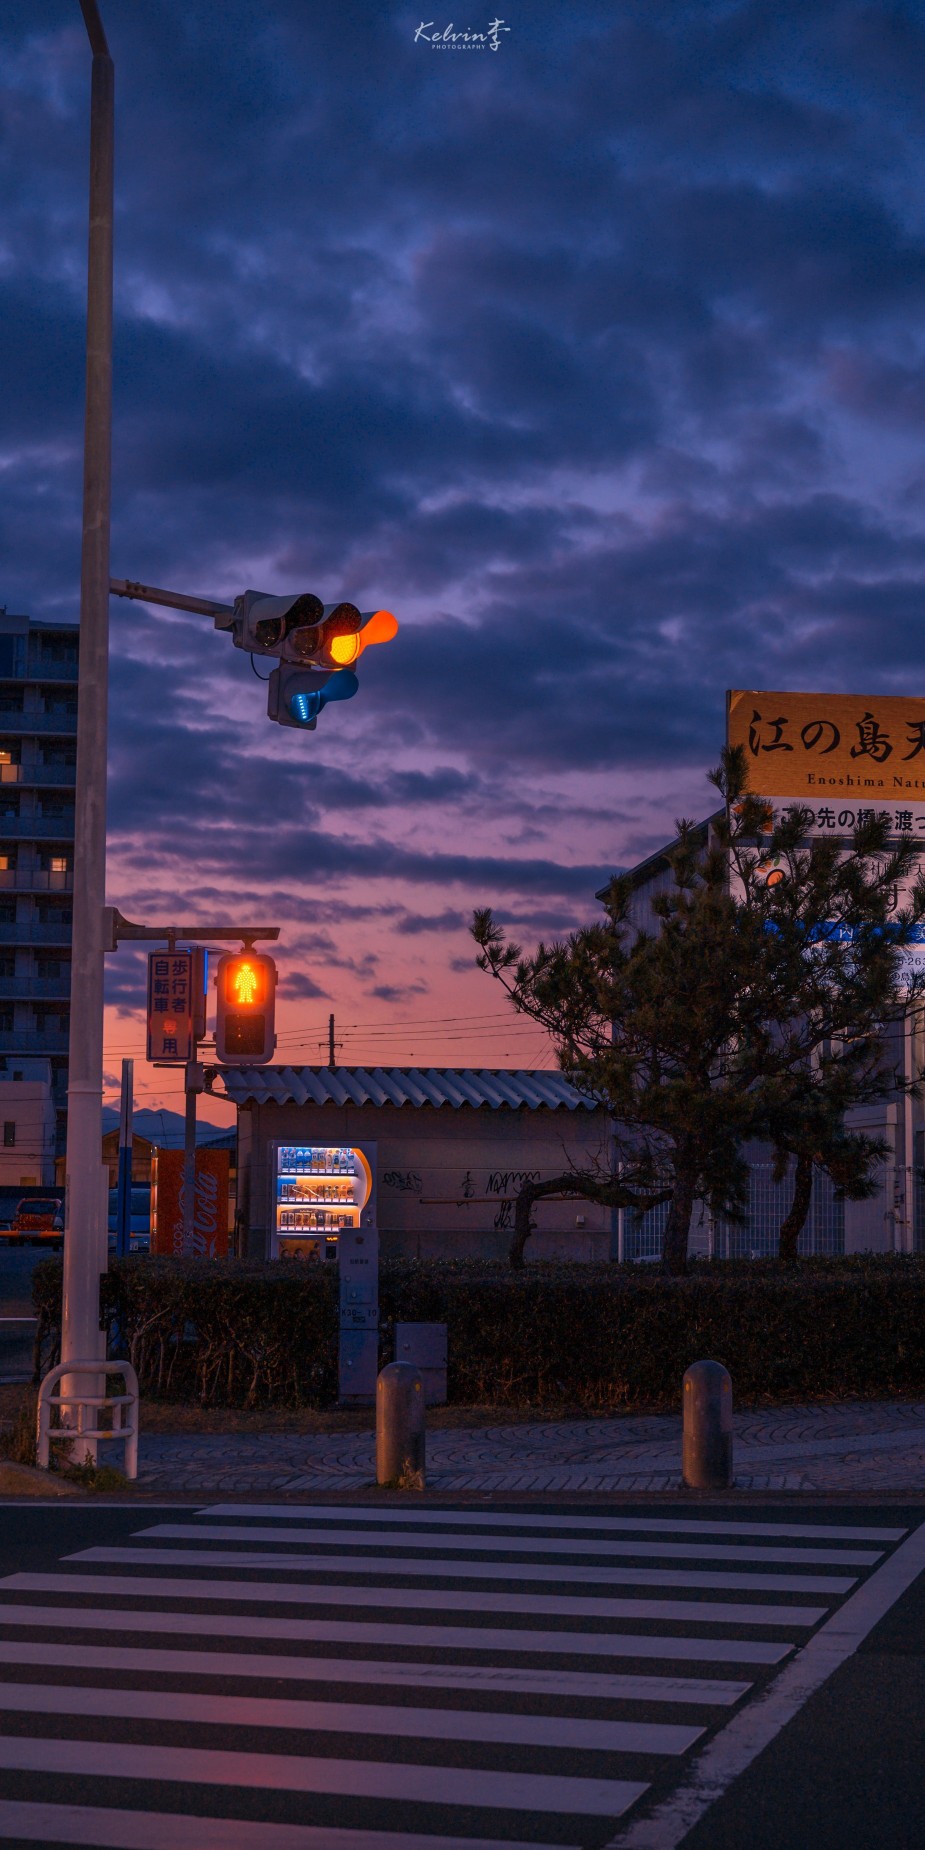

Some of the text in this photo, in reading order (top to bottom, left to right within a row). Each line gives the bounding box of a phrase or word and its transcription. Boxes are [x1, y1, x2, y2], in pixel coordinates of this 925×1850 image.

[807, 773, 884, 786] Enoshima
[153, 960, 170, 1014] 自転車
[171, 960, 188, 1013] 歩行者
